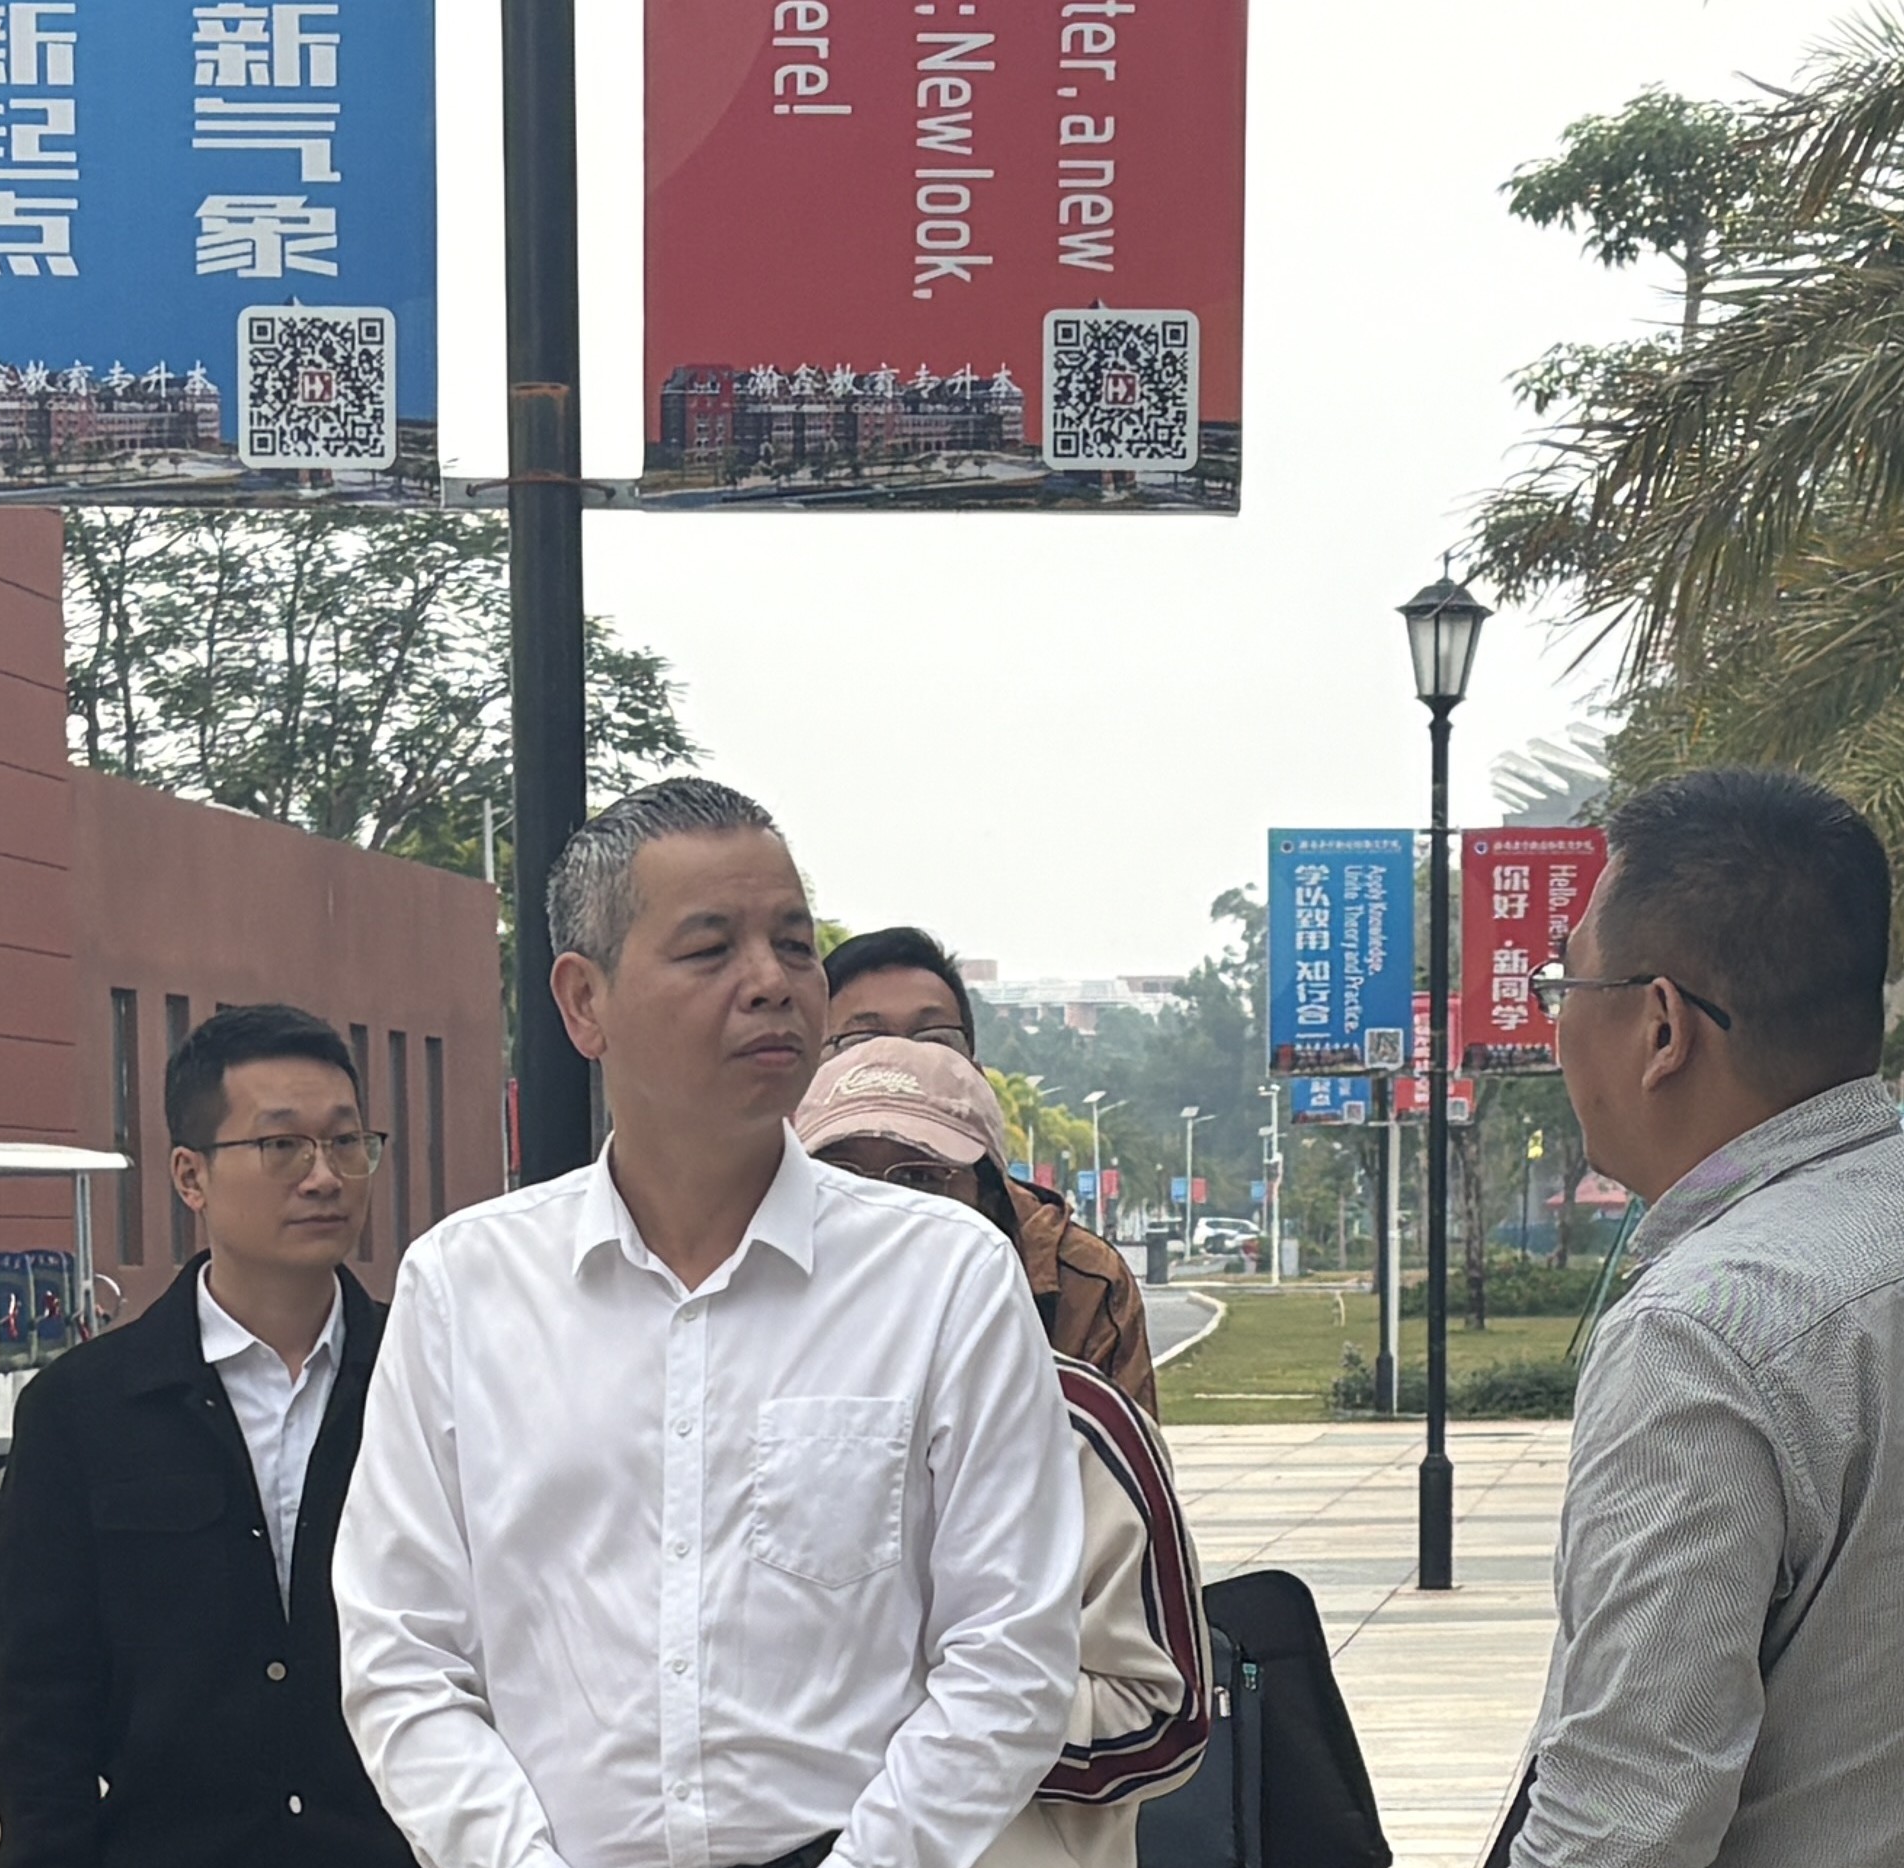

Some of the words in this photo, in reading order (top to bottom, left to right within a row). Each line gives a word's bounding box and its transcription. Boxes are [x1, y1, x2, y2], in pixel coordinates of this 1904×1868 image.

[192, 2, 342, 279] 新气象
[916, 33, 997, 156] New
[1059, 114, 1116, 146] a
[912, 168, 996, 300] look,
[1058, 160, 1116, 273] new
[1492, 865, 1531, 920] 你好
[1491, 940, 1529, 1031] 新同学
